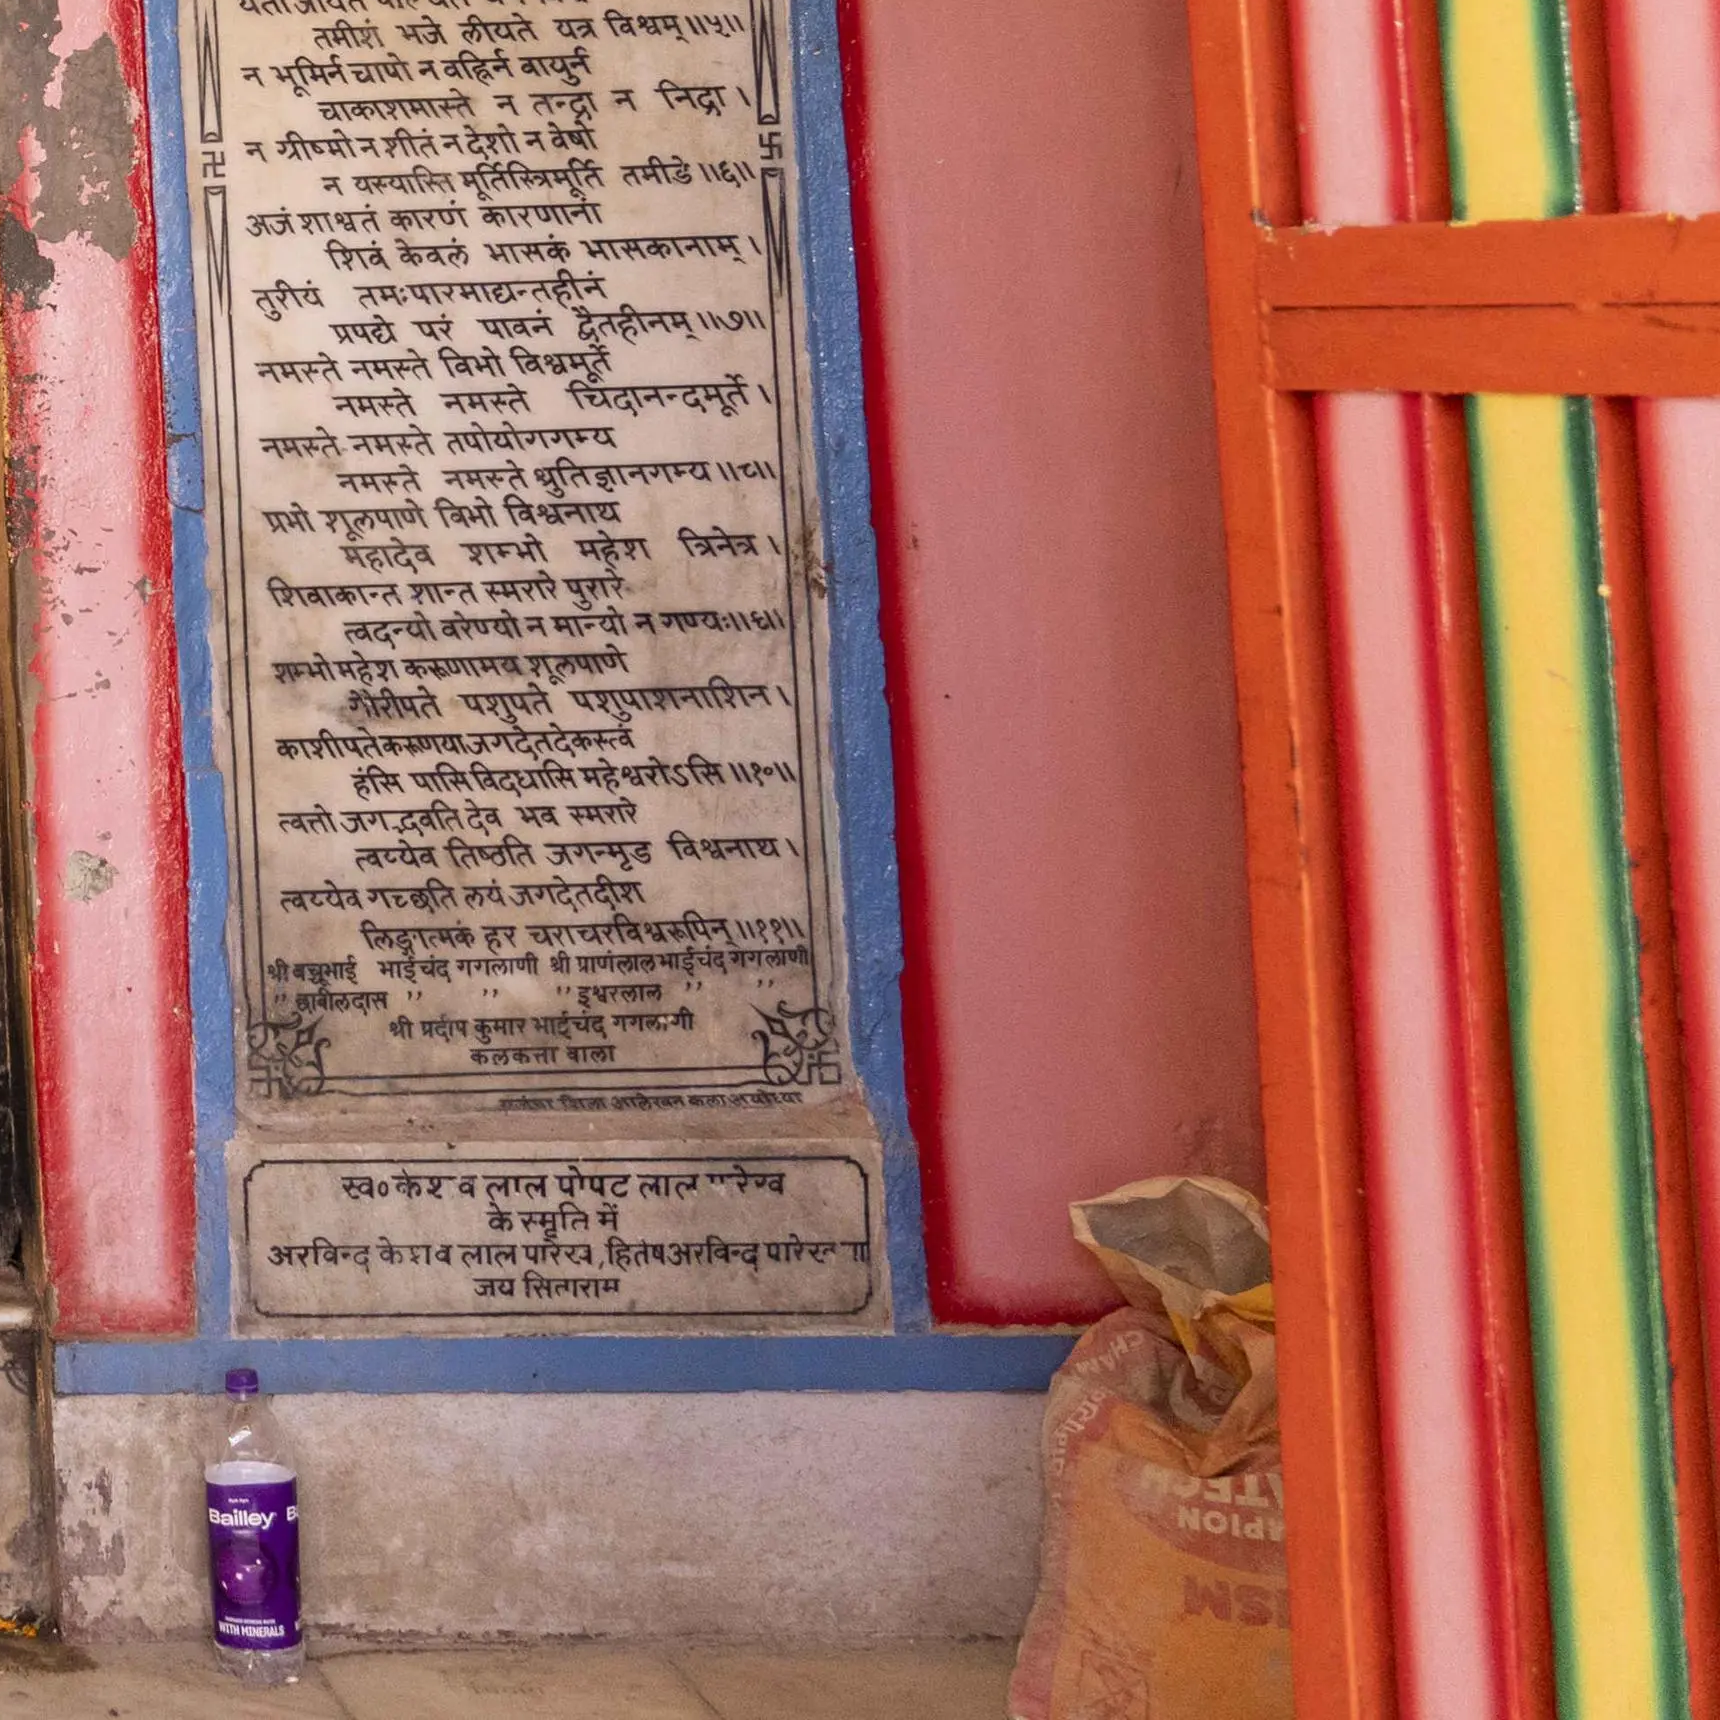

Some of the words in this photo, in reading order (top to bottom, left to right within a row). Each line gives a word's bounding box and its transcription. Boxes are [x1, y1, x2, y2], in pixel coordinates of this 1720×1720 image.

[312, 19, 384, 49] तमीशं
[397, 16, 447, 44] भजे
[458, 13, 538, 43] लीयते
[552, 18, 597, 39] यत्र
[493, 95, 519, 115] न
[529, 92, 597, 129] तन्द्रा
[610, 89, 637, 111] न
[657, 81, 726, 117] निद्रा
[246, 207, 295, 237] अजं
[297, 204, 380, 235] शाश्वतं
[388, 208, 468, 231] कारणं
[478, 197, 602, 227] कारणानां
[324, 239, 389, 271] शिवं
[395, 237, 469, 267] केवलं
[484, 241, 571, 263] भासकं
[252, 279, 324, 322] तुरीयं
[411, 313, 454, 341] परं
[476, 309, 553, 338] पावनं
[255, 352, 343, 383] नमस्ते
[348, 348, 432, 379] नमस्ते
[438, 346, 505, 377] विभो
[331, 387, 417, 417] नमस्ते
[440, 383, 530, 413] नमस्ते
[336, 464, 421, 493] नमस्ते
[441, 460, 528, 490] नमस्ते
[261, 502, 315, 533] प्रभो
[434, 496, 498, 528] विभो
[505, 495, 621, 526] विश्वनाथ
[339, 537, 435, 574] महादेव
[464, 533, 548, 565] शम्भो
[574, 530, 651, 568] महेश
[677, 526, 758, 557] त्रिनेत्र
[267, 575, 402, 607] शिवाकान्त
[408, 582, 477, 605] शान्त
[481, 570, 556, 601] स्मरारे
[562, 568, 625, 611] पुरारे
[457, 682, 553, 724] पशुपते
[445, 834, 535, 868] तिष्ठति
[462, 879, 506, 908] लयं
[482, 1175, 548, 1200] लाल
[487, 1202, 513, 1231] के
[597, 1202, 618, 1231] में
[457, 1244, 517, 1267] लाल
[473, 1279, 515, 1296] जय
[241, 1623, 284, 1638] MINERALS
